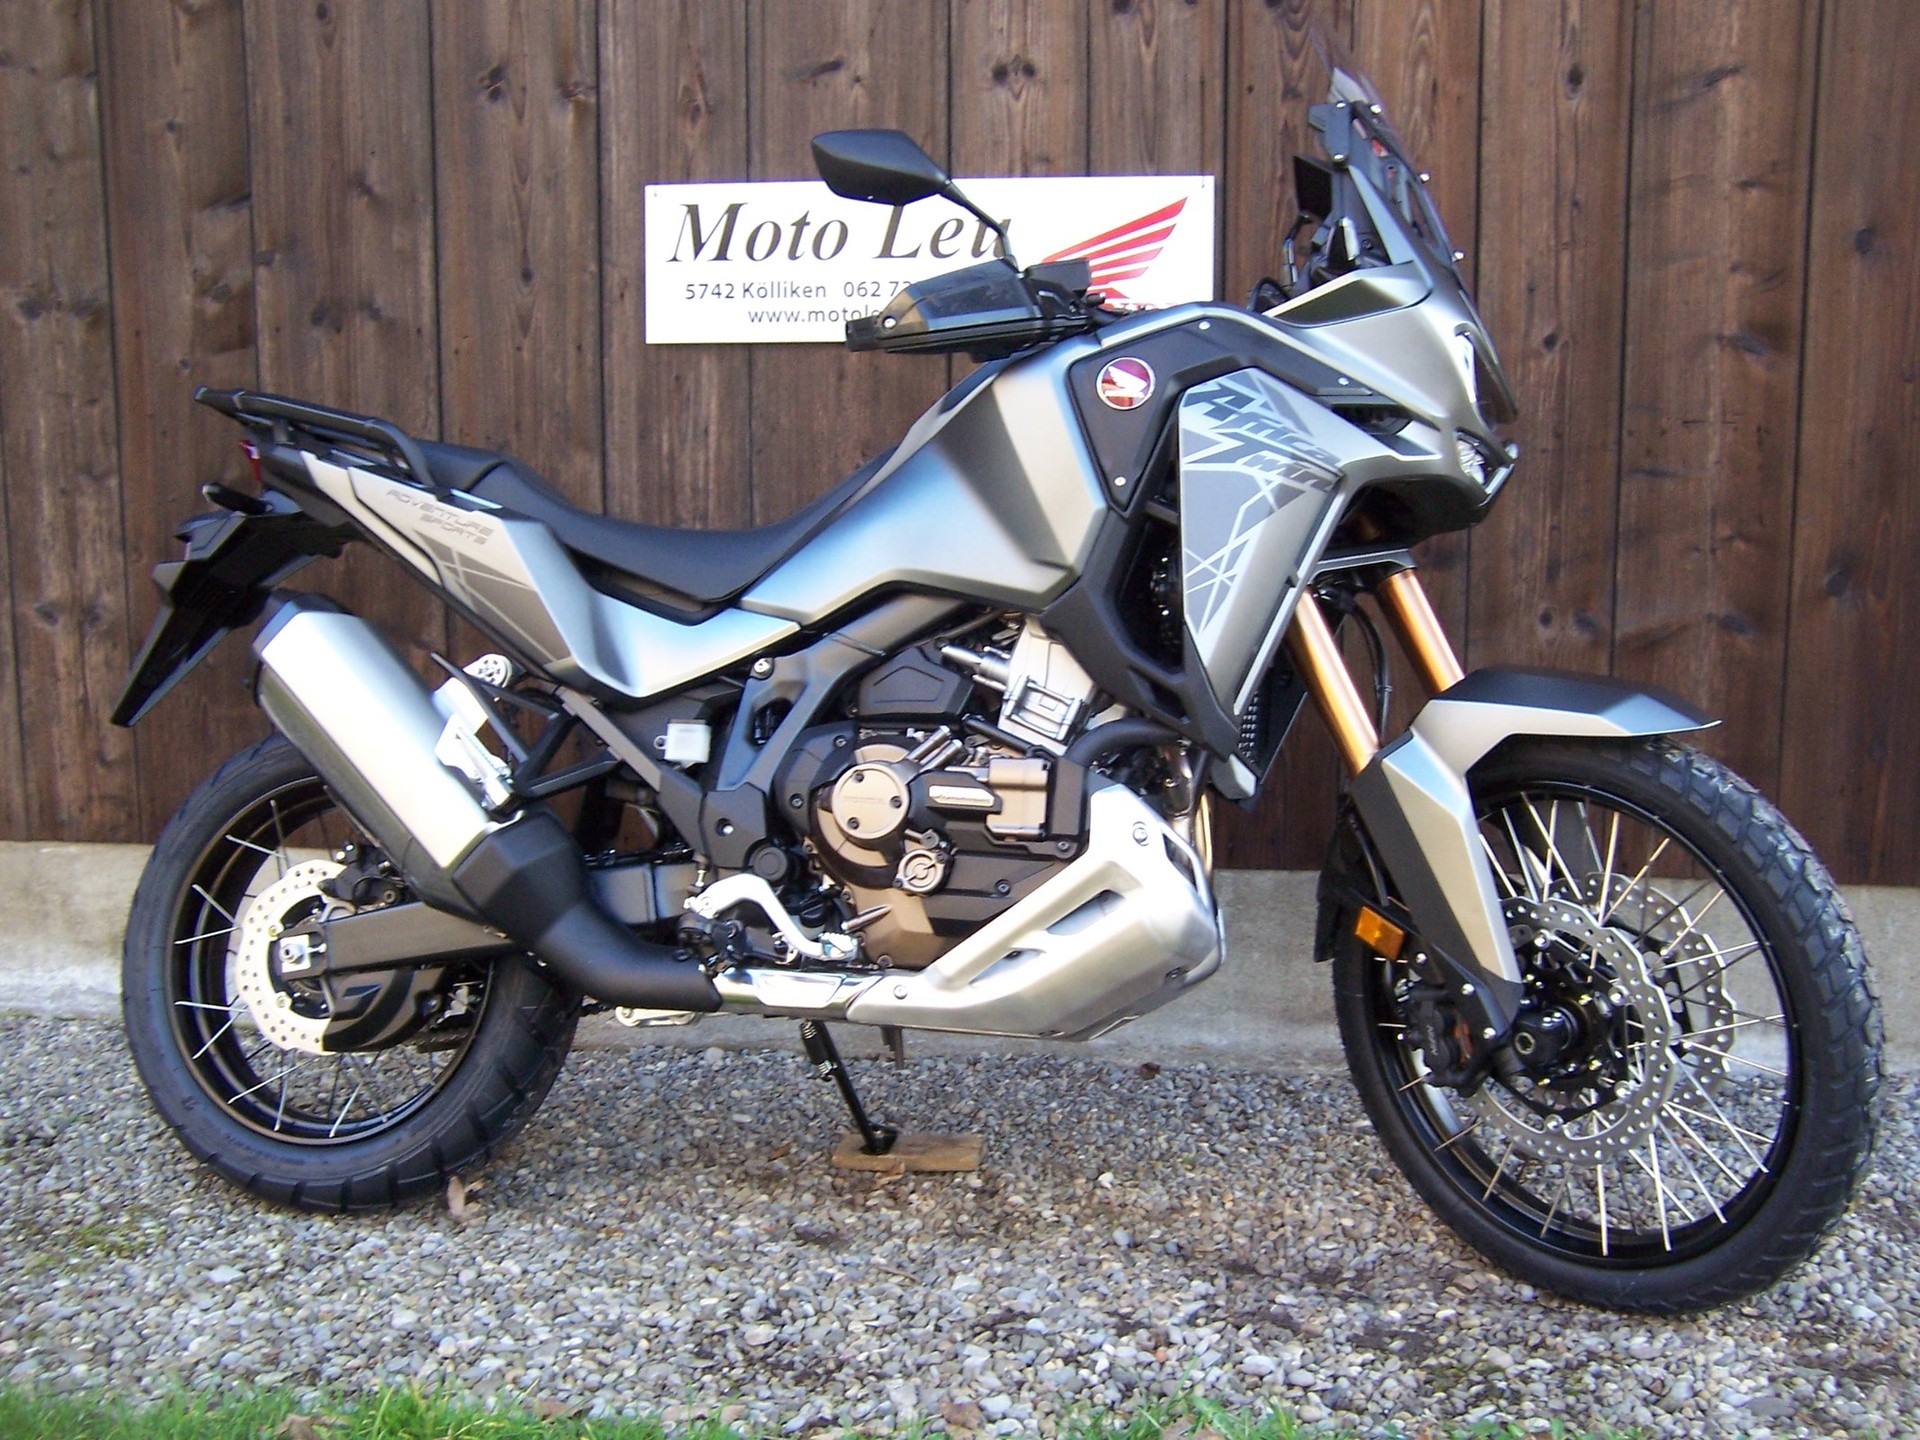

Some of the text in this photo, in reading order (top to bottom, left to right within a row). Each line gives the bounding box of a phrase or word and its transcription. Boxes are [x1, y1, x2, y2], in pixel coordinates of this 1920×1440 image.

[665, 202, 1012, 262] Moto Leu
[685, 283, 736, 300] 5742
[742, 280, 827, 299] Kölliken
[843, 281, 881, 298] 062
